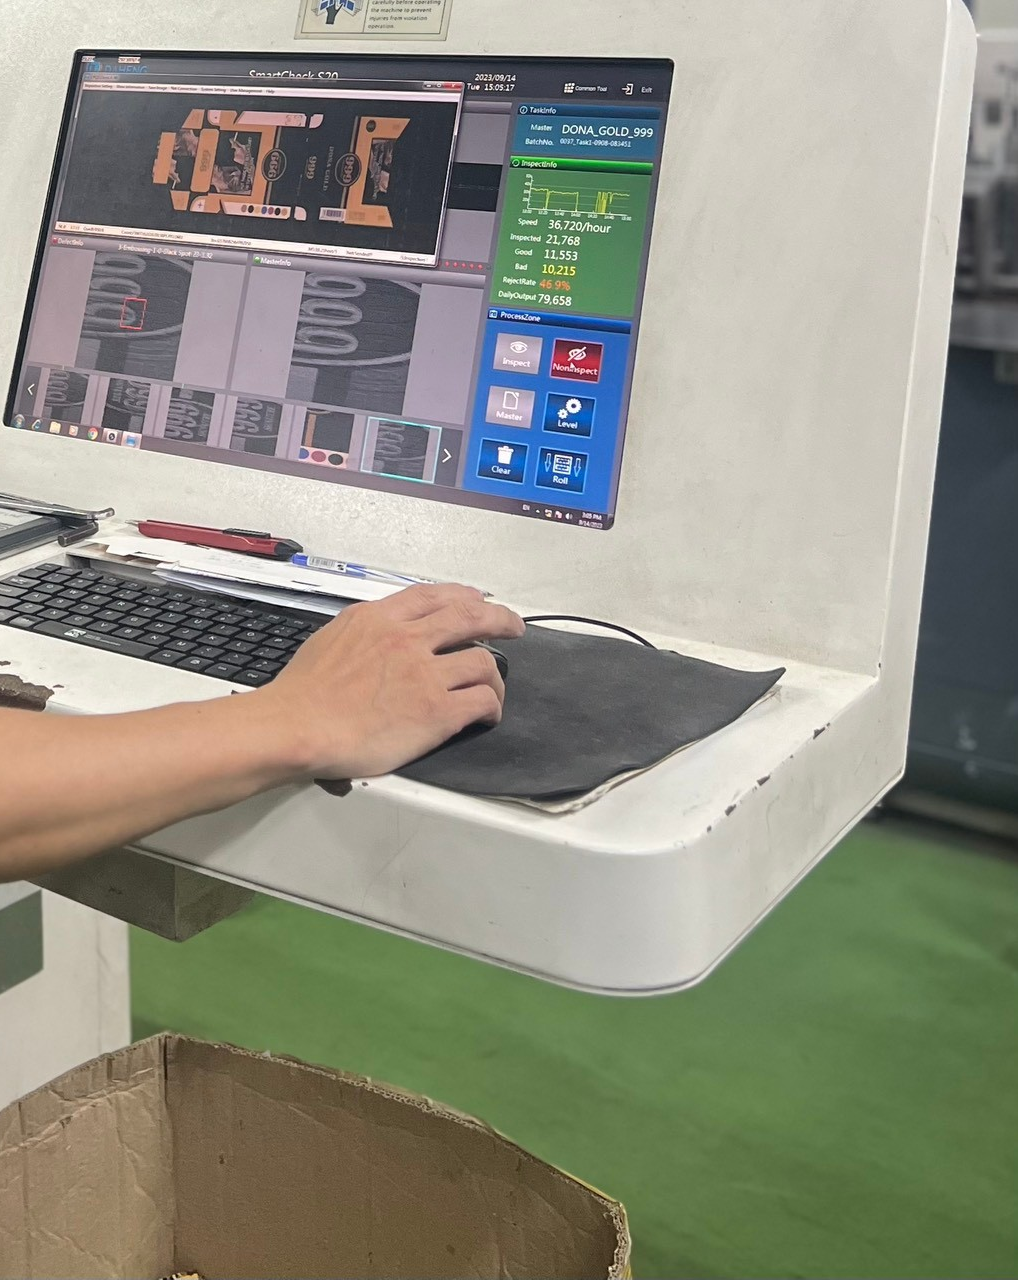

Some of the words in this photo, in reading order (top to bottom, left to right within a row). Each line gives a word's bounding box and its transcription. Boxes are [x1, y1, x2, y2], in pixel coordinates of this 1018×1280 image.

[474, 74, 516, 82] 2023/09/14
[484, 84, 515, 92] 15:05:17
[641, 86, 652, 94] Exit
[530, 124, 552, 132] Master
[562, 124, 653, 138] DONA_GOLD_999
[525, 138, 554, 146] BatchNo.
[521, 160, 557, 169] InspectInfo
[518, 218, 538, 226] Speed
[548, 219, 612, 234] 36,720/hour
[510, 234, 541, 243] Inspected
[546, 234, 580, 246] 21,768
[514, 248, 533, 256] Good
[544, 249, 578, 261] 11,553
[542, 264, 576, 276] 10,215
[502, 277, 536, 286] RejectRate
[498, 291, 537, 301] DailyOutput
[538, 294, 572, 306] 79,658
[500, 311, 541, 322] ProcessZone
[502, 358, 531, 368] Inspect
[496, 410, 523, 421] Master
[558, 420, 578, 429] Level
[491, 465, 511, 475] Clear
[552, 476, 568, 485] Roll
